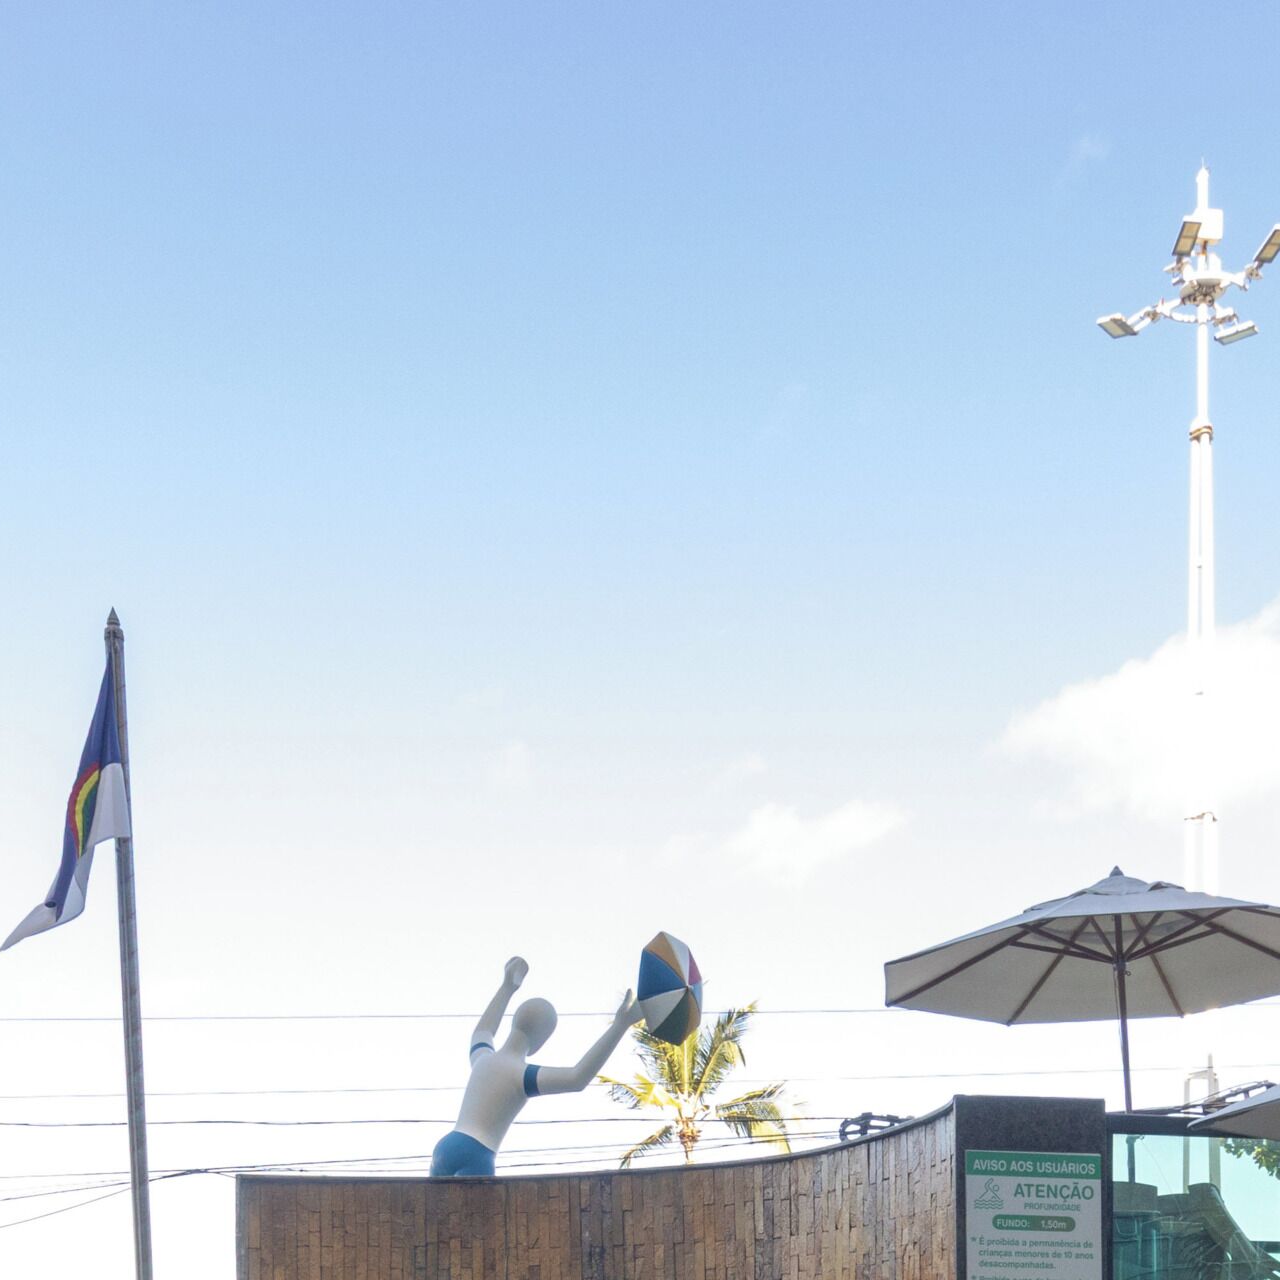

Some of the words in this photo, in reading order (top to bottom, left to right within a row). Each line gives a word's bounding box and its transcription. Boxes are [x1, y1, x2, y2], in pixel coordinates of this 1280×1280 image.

[973, 1159, 1007, 1172] AVISO
[1010, 1160, 1034, 1173] AOS
[1036, 1160, 1096, 1175] USUÁRIOS
[1013, 1182, 1095, 1203] ATENÇÃO
[1024, 1202, 1081, 1212] PROFUNDIDADE
[996, 1218, 1031, 1228] FUNDO:
[986, 1238, 1020, 1249] proibida
[1029, 1239, 1081, 1250] permanência
[1083, 1240, 1094, 1249] de
[979, 1249, 1013, 1259] crianças
[1014, 1250, 1050, 1259] menores
[1051, 1250, 1062, 1259] de
[1064, 1250, 1073, 1259] 10
[1075, 1252, 1094, 1260] anos
